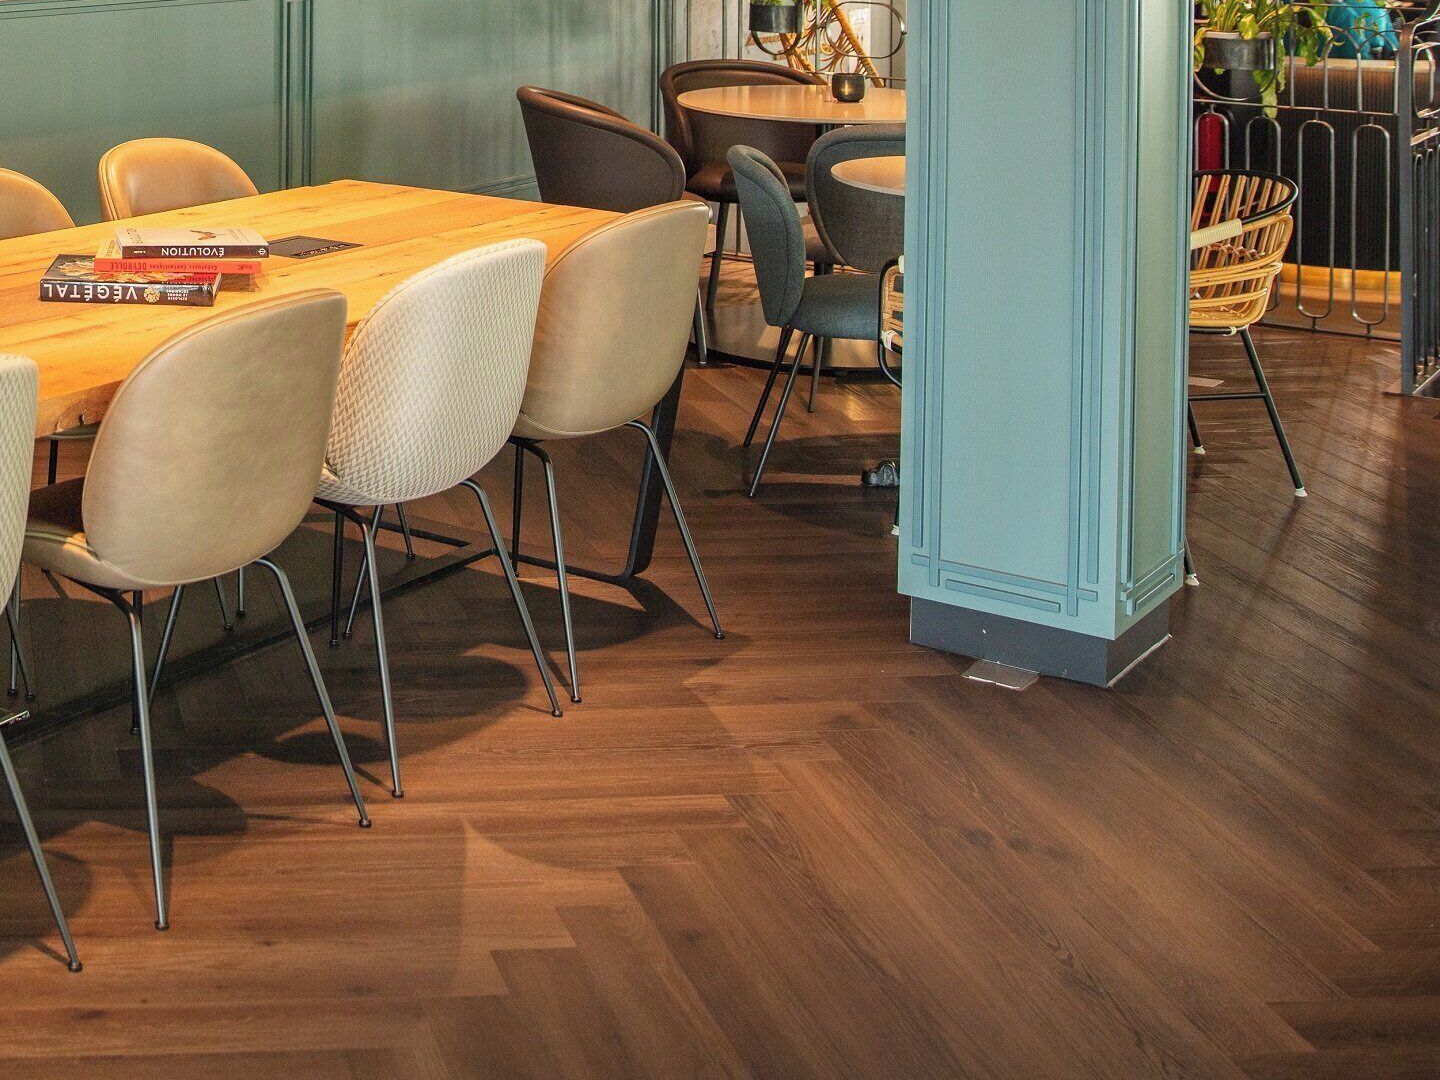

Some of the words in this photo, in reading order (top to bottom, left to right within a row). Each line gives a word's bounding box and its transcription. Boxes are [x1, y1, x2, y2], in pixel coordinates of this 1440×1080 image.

[161, 247, 225, 259] ÉVOLUTION
[110, 262, 147, 271] DEYROLLE
[43, 283, 138, 302] VÉGÉTAL
